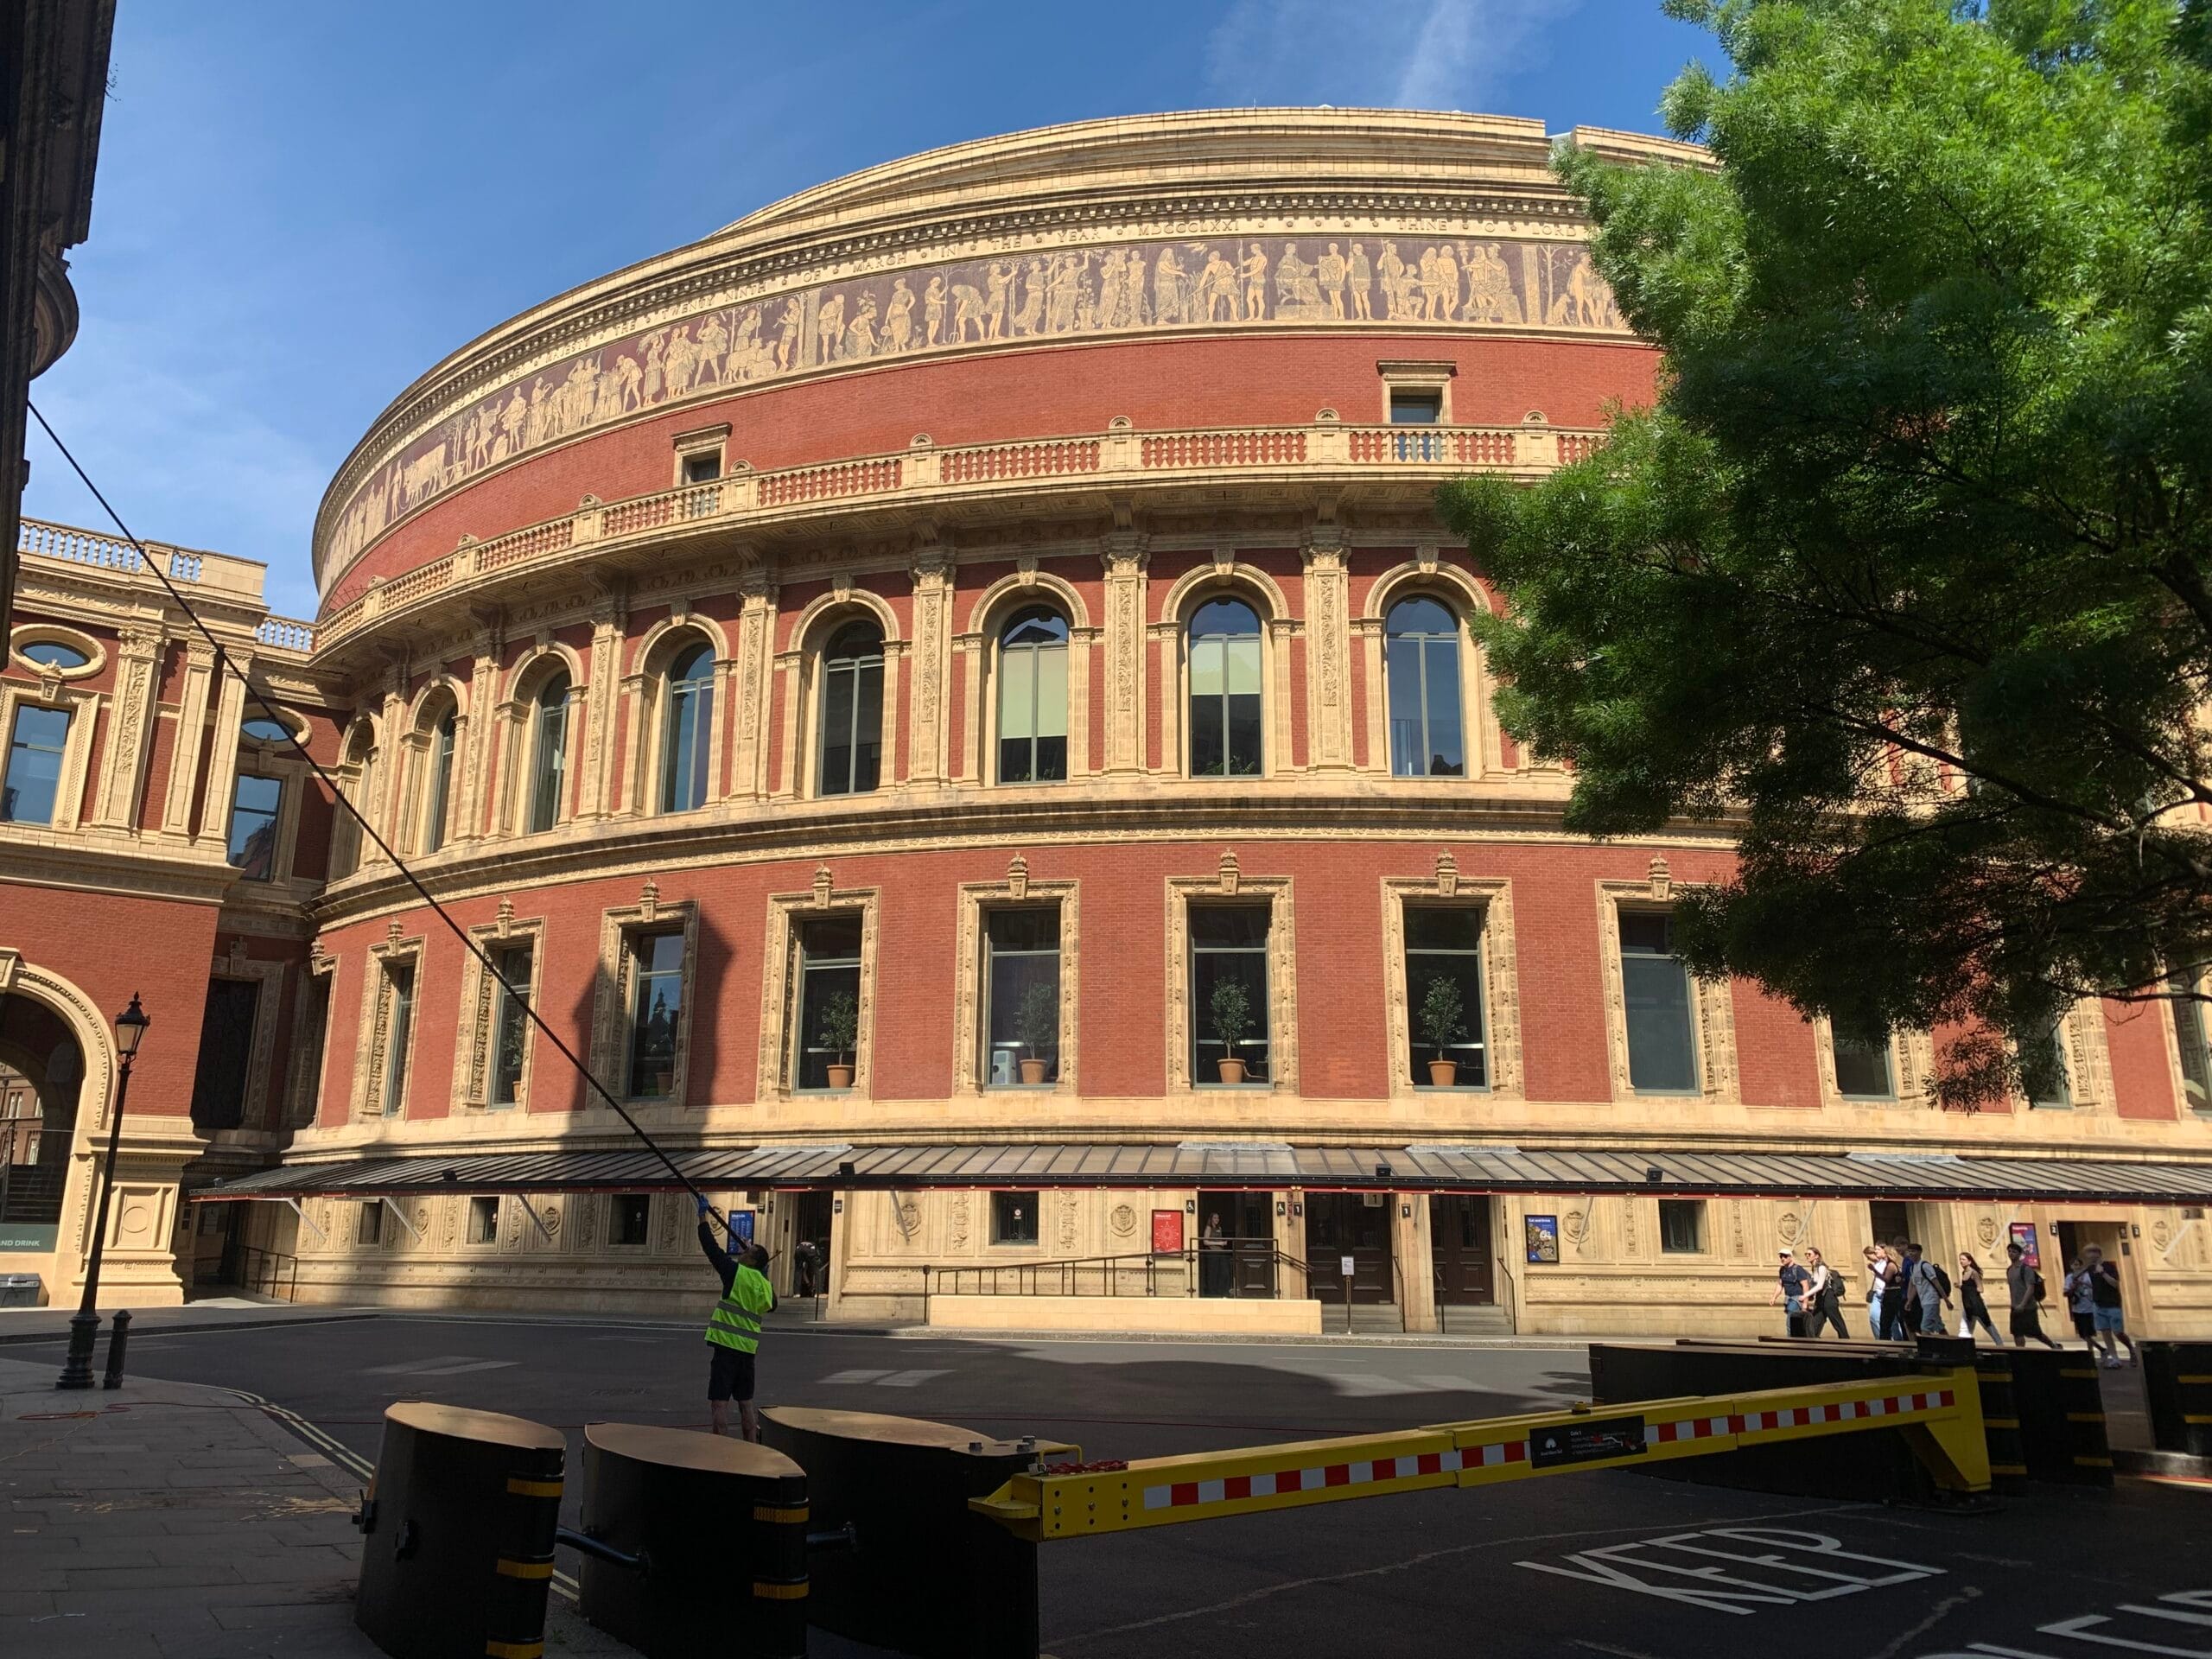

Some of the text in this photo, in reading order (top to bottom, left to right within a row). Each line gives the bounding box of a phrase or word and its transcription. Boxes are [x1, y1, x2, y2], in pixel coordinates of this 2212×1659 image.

[1396, 219, 1577, 237] THINE O LORD
[545, 334, 592, 362] MAJESTY
[613, 320, 636, 336] THE
[661, 296, 715, 320] TWENTY
[724, 281, 766, 302] NINTH
[804, 270, 821, 282] OF
[853, 251, 907, 273] MARCH
[940, 245, 957, 257] IN
[990, 236, 1021, 251] THE
[1057, 229, 1101, 243] YEAR
[1138, 220, 1239, 236] MDCCCLXXI
[1512, 1528, 1948, 1615] KEEP
